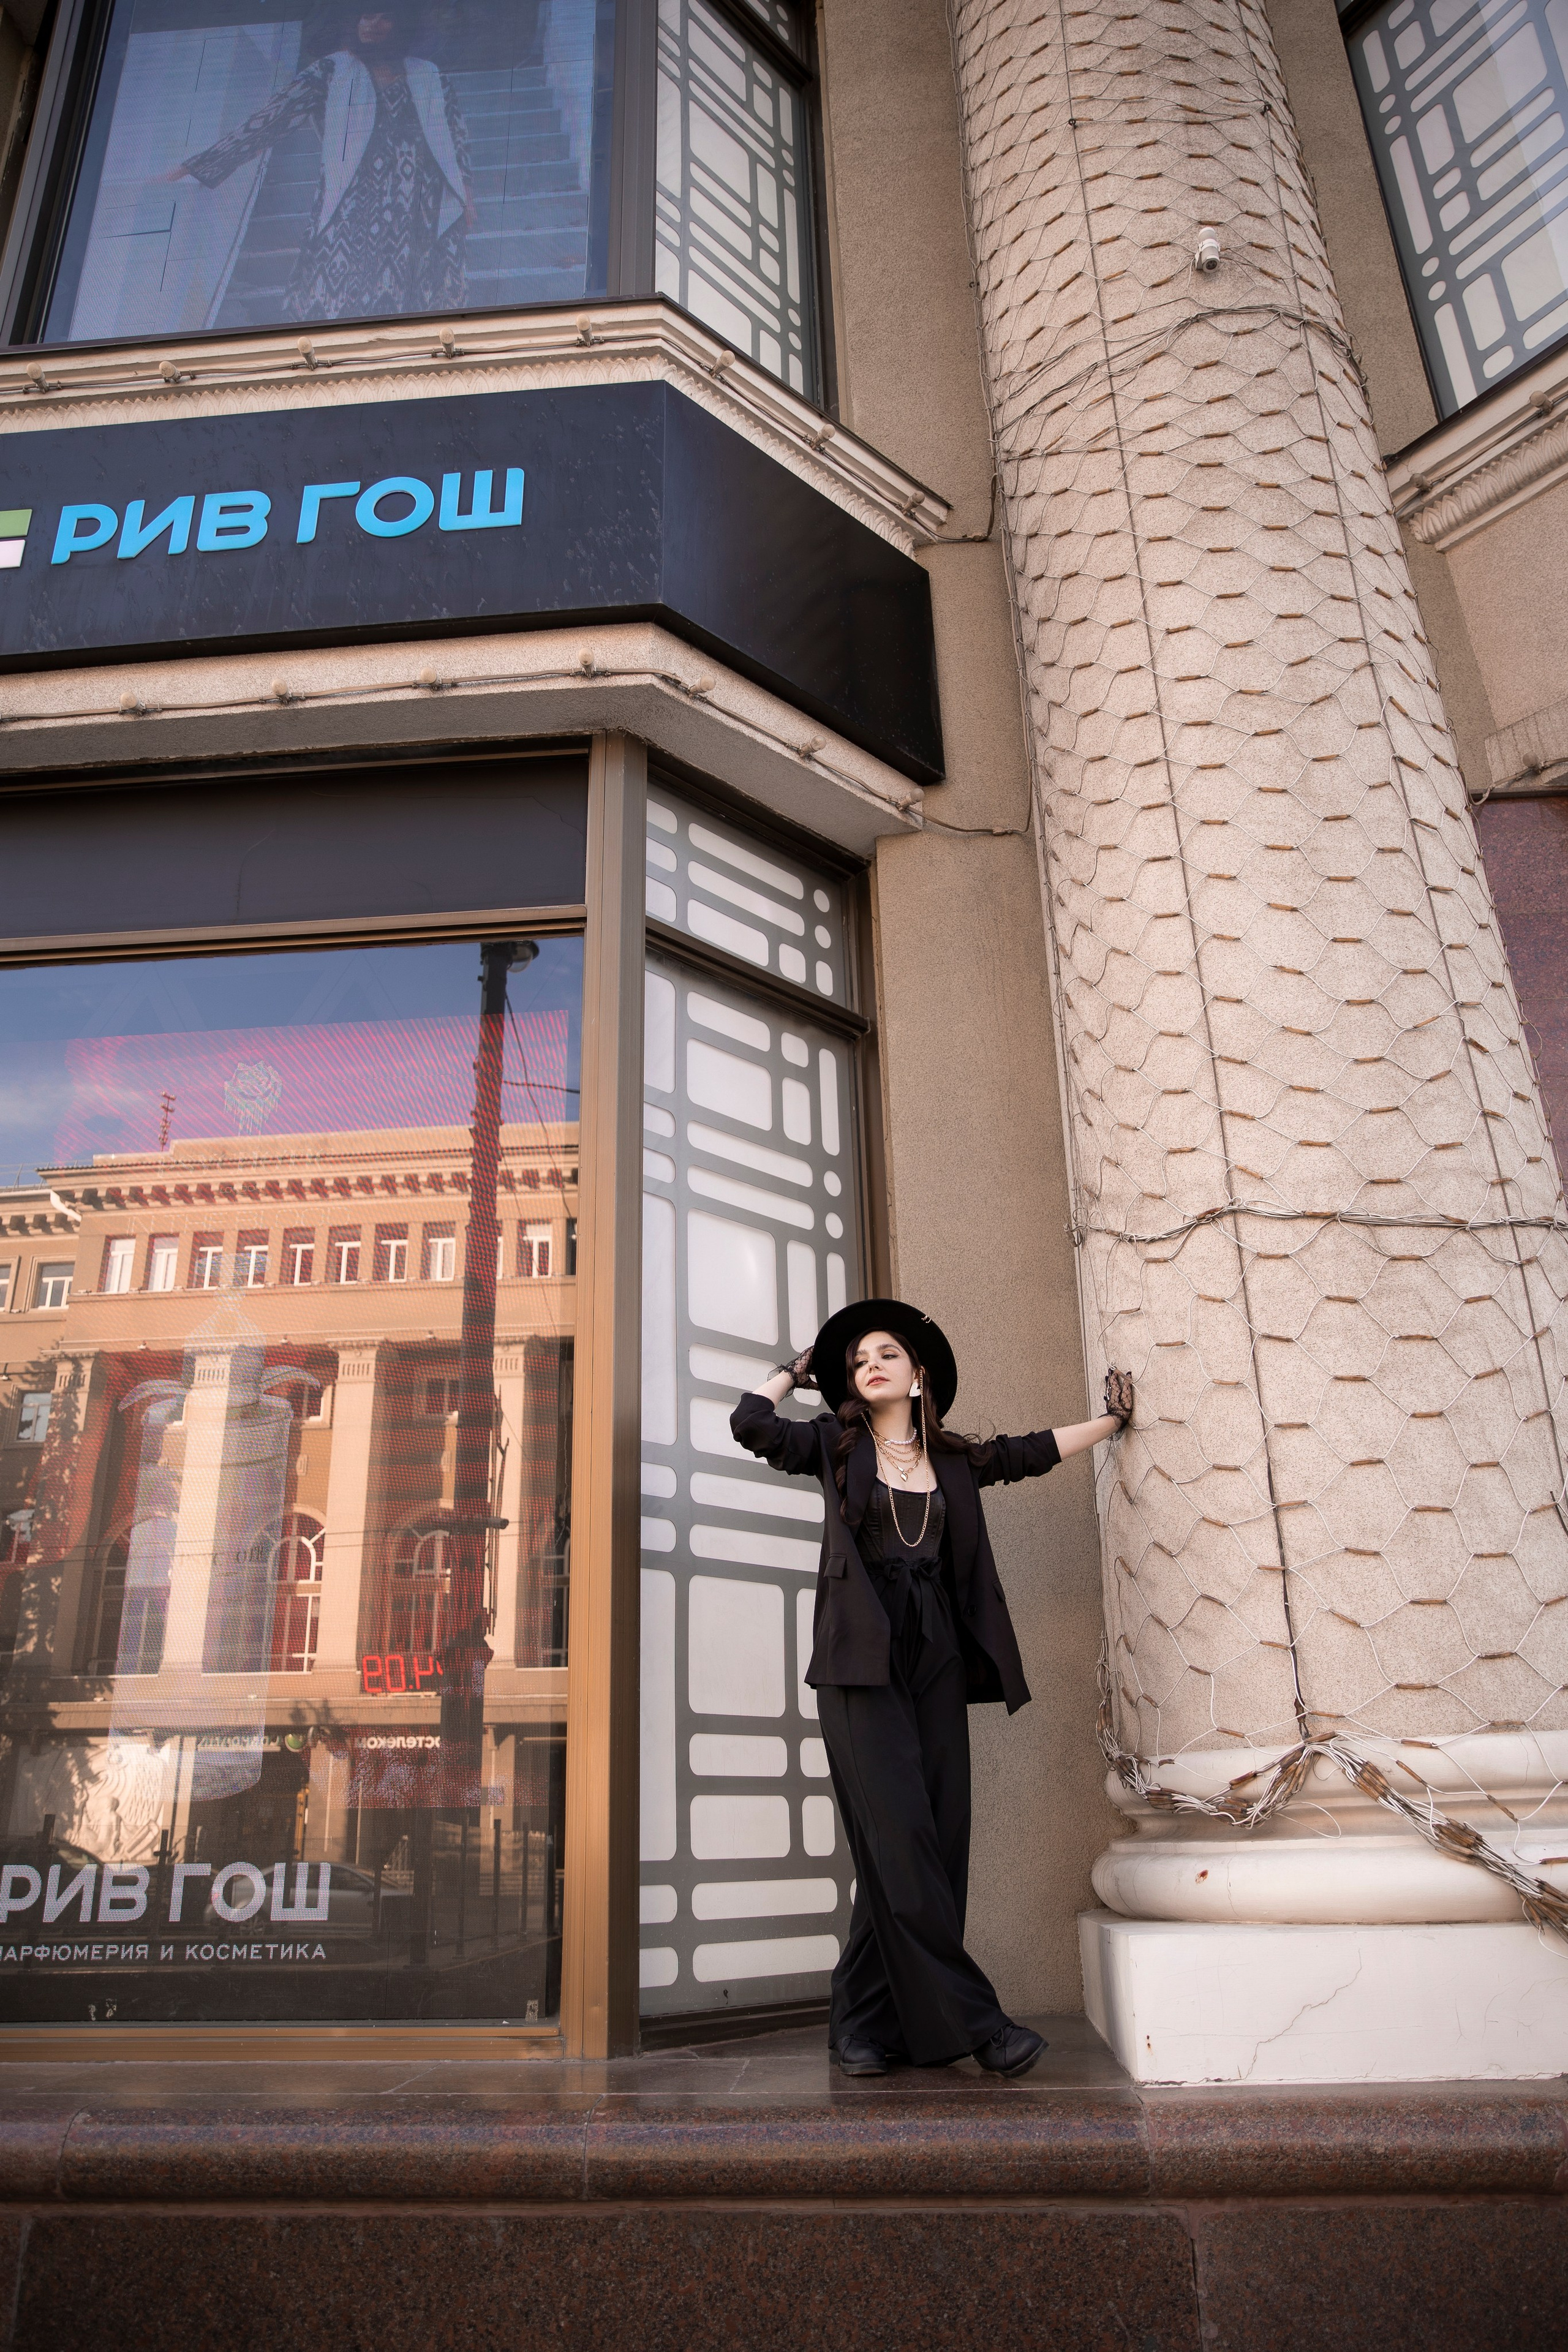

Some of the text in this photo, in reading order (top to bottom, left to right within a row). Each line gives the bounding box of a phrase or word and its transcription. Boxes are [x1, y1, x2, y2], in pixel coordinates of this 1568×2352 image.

[51, 467, 525, 565] РИВ ГОШ
[159, 1212, 228, 1234] THE
[236, 1206, 351, 1231] BLOOD
[0, 1861, 331, 1923] РИВ ГОШ
[160, 1944, 174, 1961] И
[186, 1943, 327, 1961] КОСМЕТИКА
